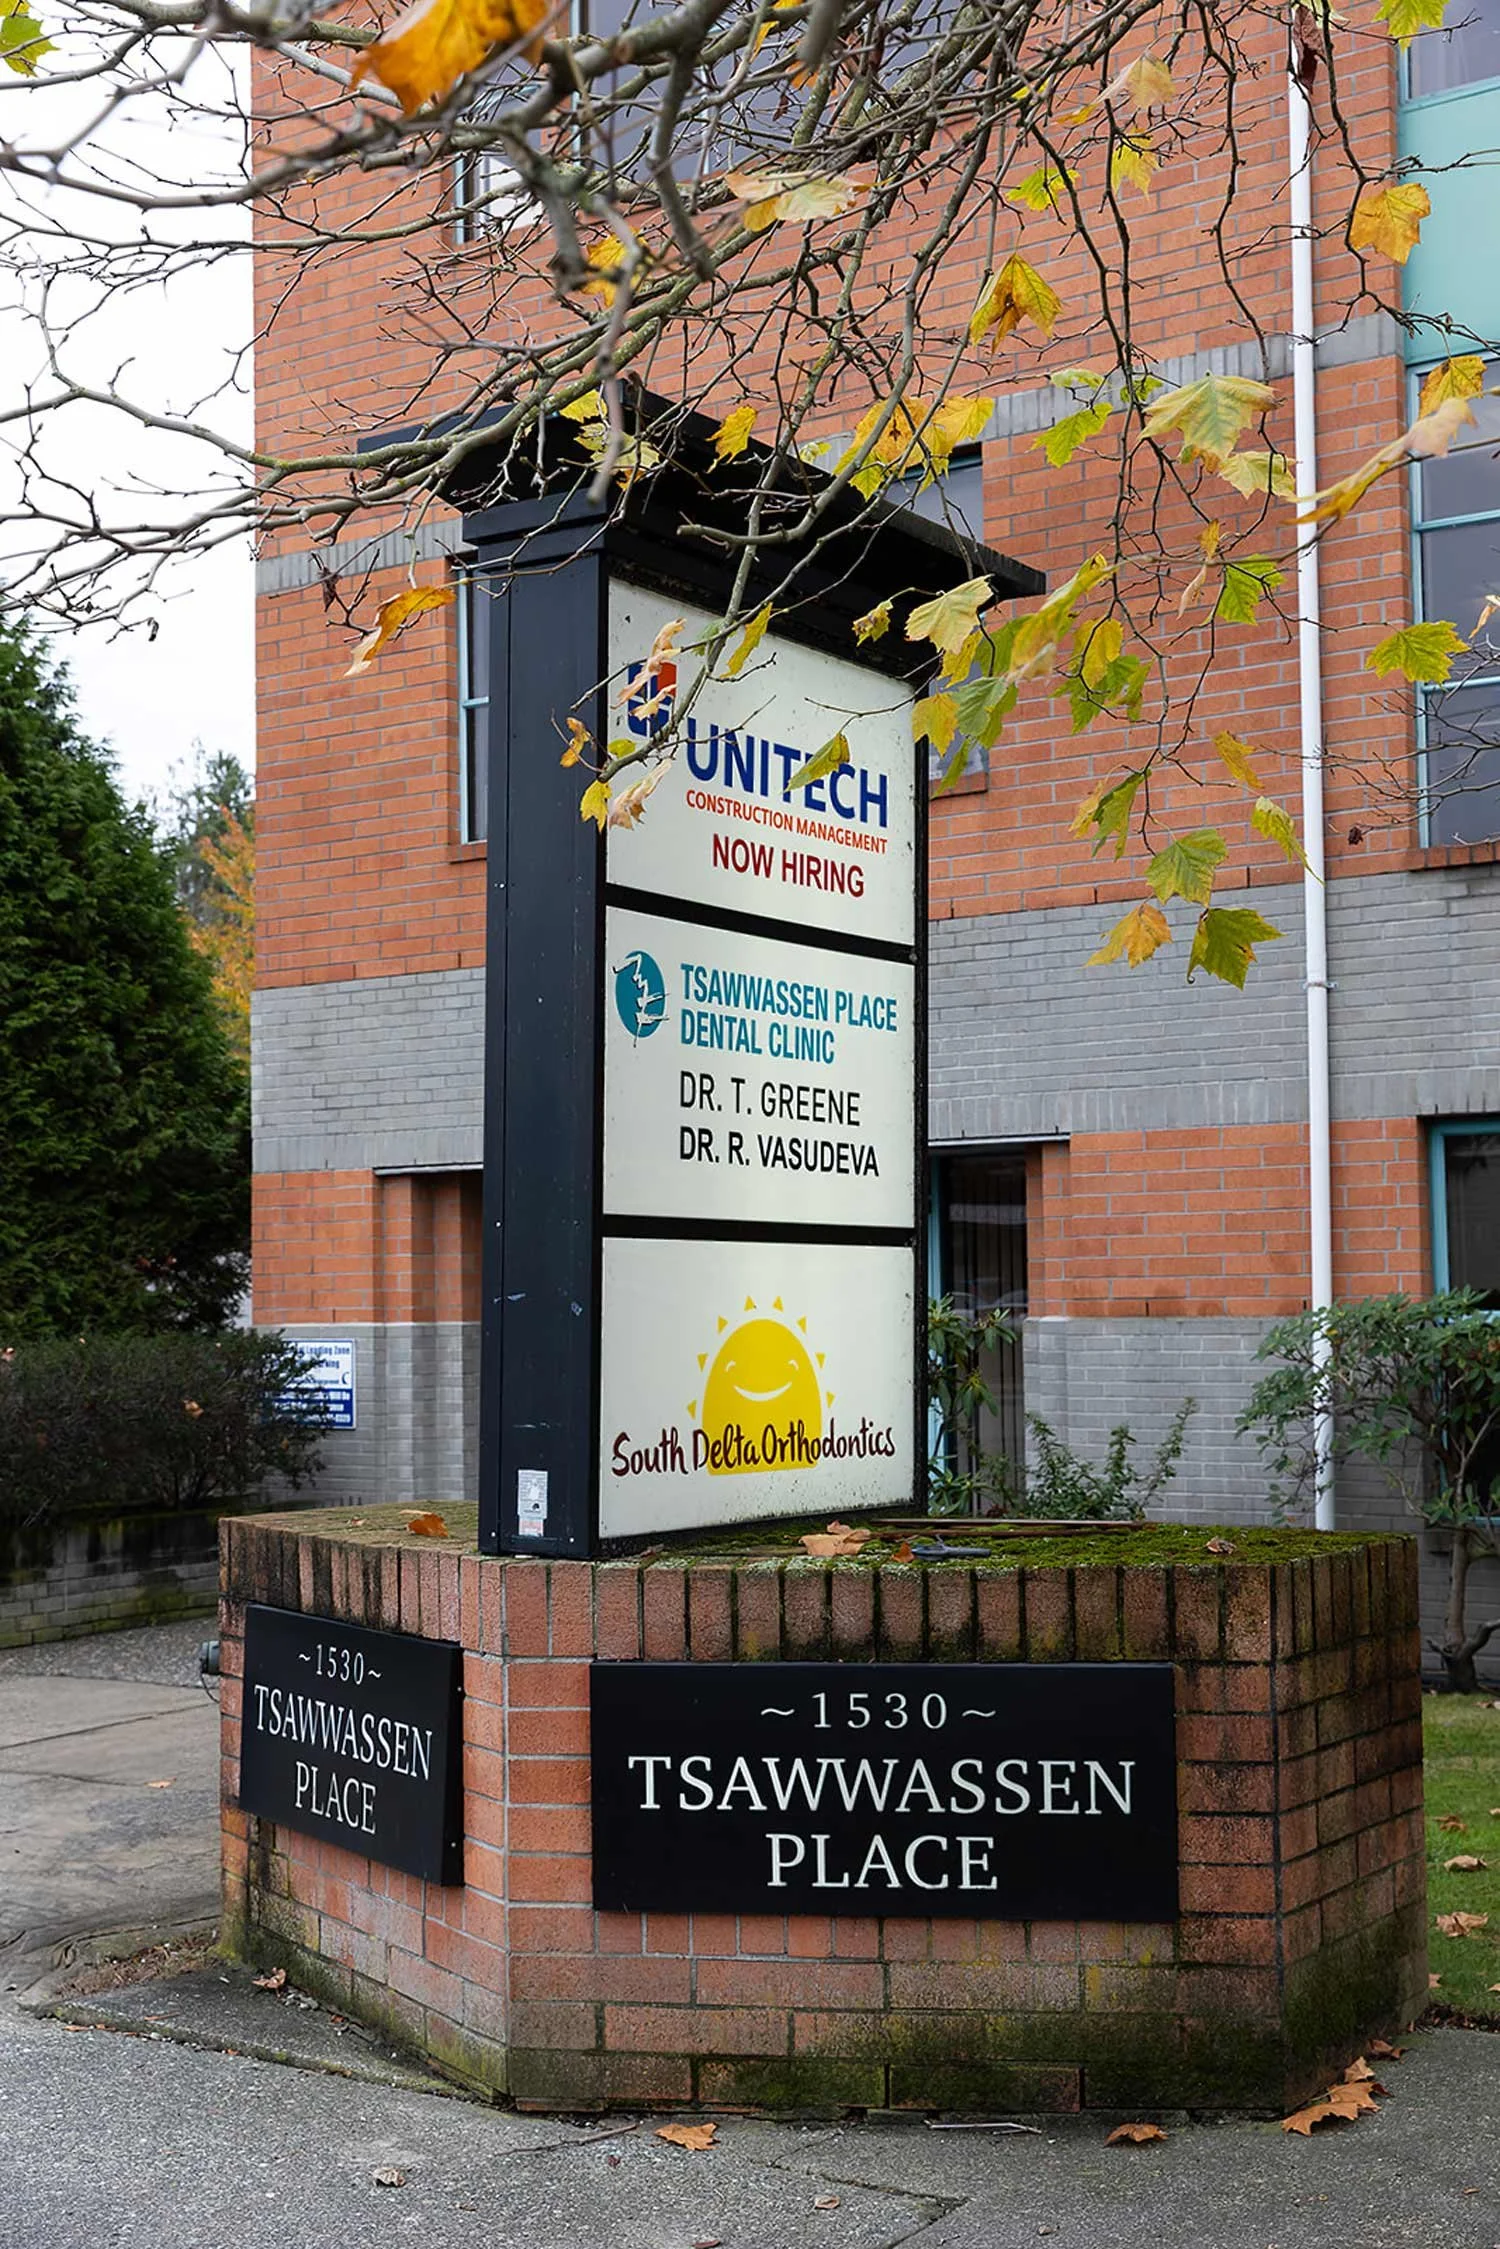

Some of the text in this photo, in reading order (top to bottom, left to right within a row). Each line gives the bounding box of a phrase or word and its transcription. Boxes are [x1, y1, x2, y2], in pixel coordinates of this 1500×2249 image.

[686, 717, 888, 828] UNITECH
[686, 789, 888, 855] CONSTRUCTION MANAGEMENT
[712, 833, 865, 898] NOW HIRING
[680, 963, 898, 1032] TSAWWASSEN PLACE
[680, 1008, 836, 1064] DENTAL CLINIC
[680, 1070, 861, 1127] DR. T. GREENE
[680, 1126, 880, 1178] DR. R. VASUDEVA
[611, 1417, 895, 1477] South Delta Orthodontics
[254, 1684, 433, 1781] TSAWWASSEN
[294, 1760, 377, 1835] PLACE
[627, 1755, 1136, 1815] TSAWWASSEN
[765, 1833, 998, 1890] PLACE
